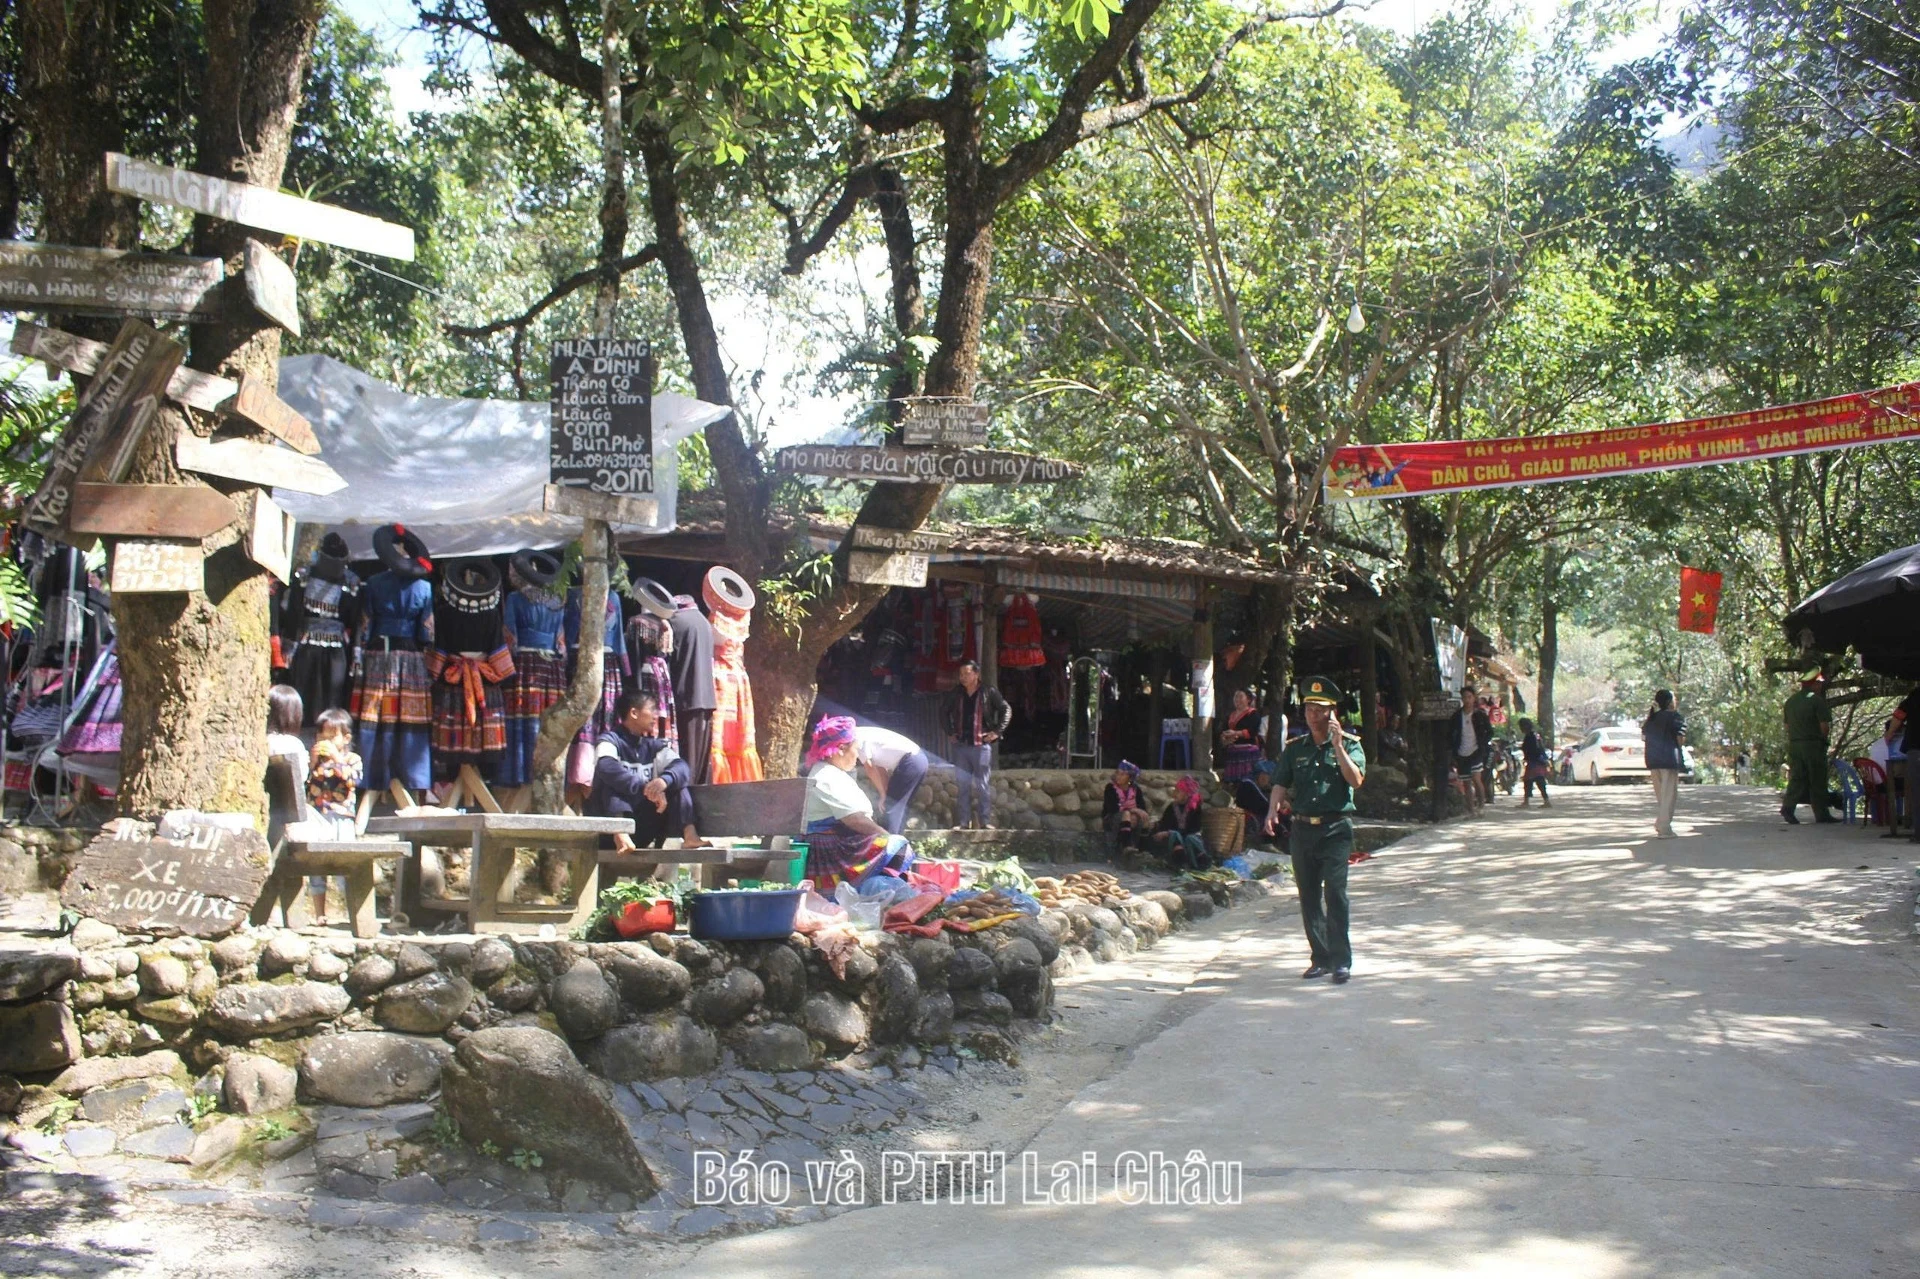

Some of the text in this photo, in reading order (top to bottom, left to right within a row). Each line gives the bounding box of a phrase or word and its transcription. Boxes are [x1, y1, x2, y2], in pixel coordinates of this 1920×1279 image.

[1431, 463, 1469, 487] DÂN
[1473, 458, 1516, 482] CHỦ,
[1520, 451, 1565, 477] GIÀU
[1569, 449, 1633, 475] MẠNH,
[1696, 436, 1751, 459] VINH,
[1756, 428, 1799, 451] VĂN
[1804, 421, 1868, 446] MINH,
[1872, 410, 1920, 438] HẠN
[129, 858, 181, 886] XE
